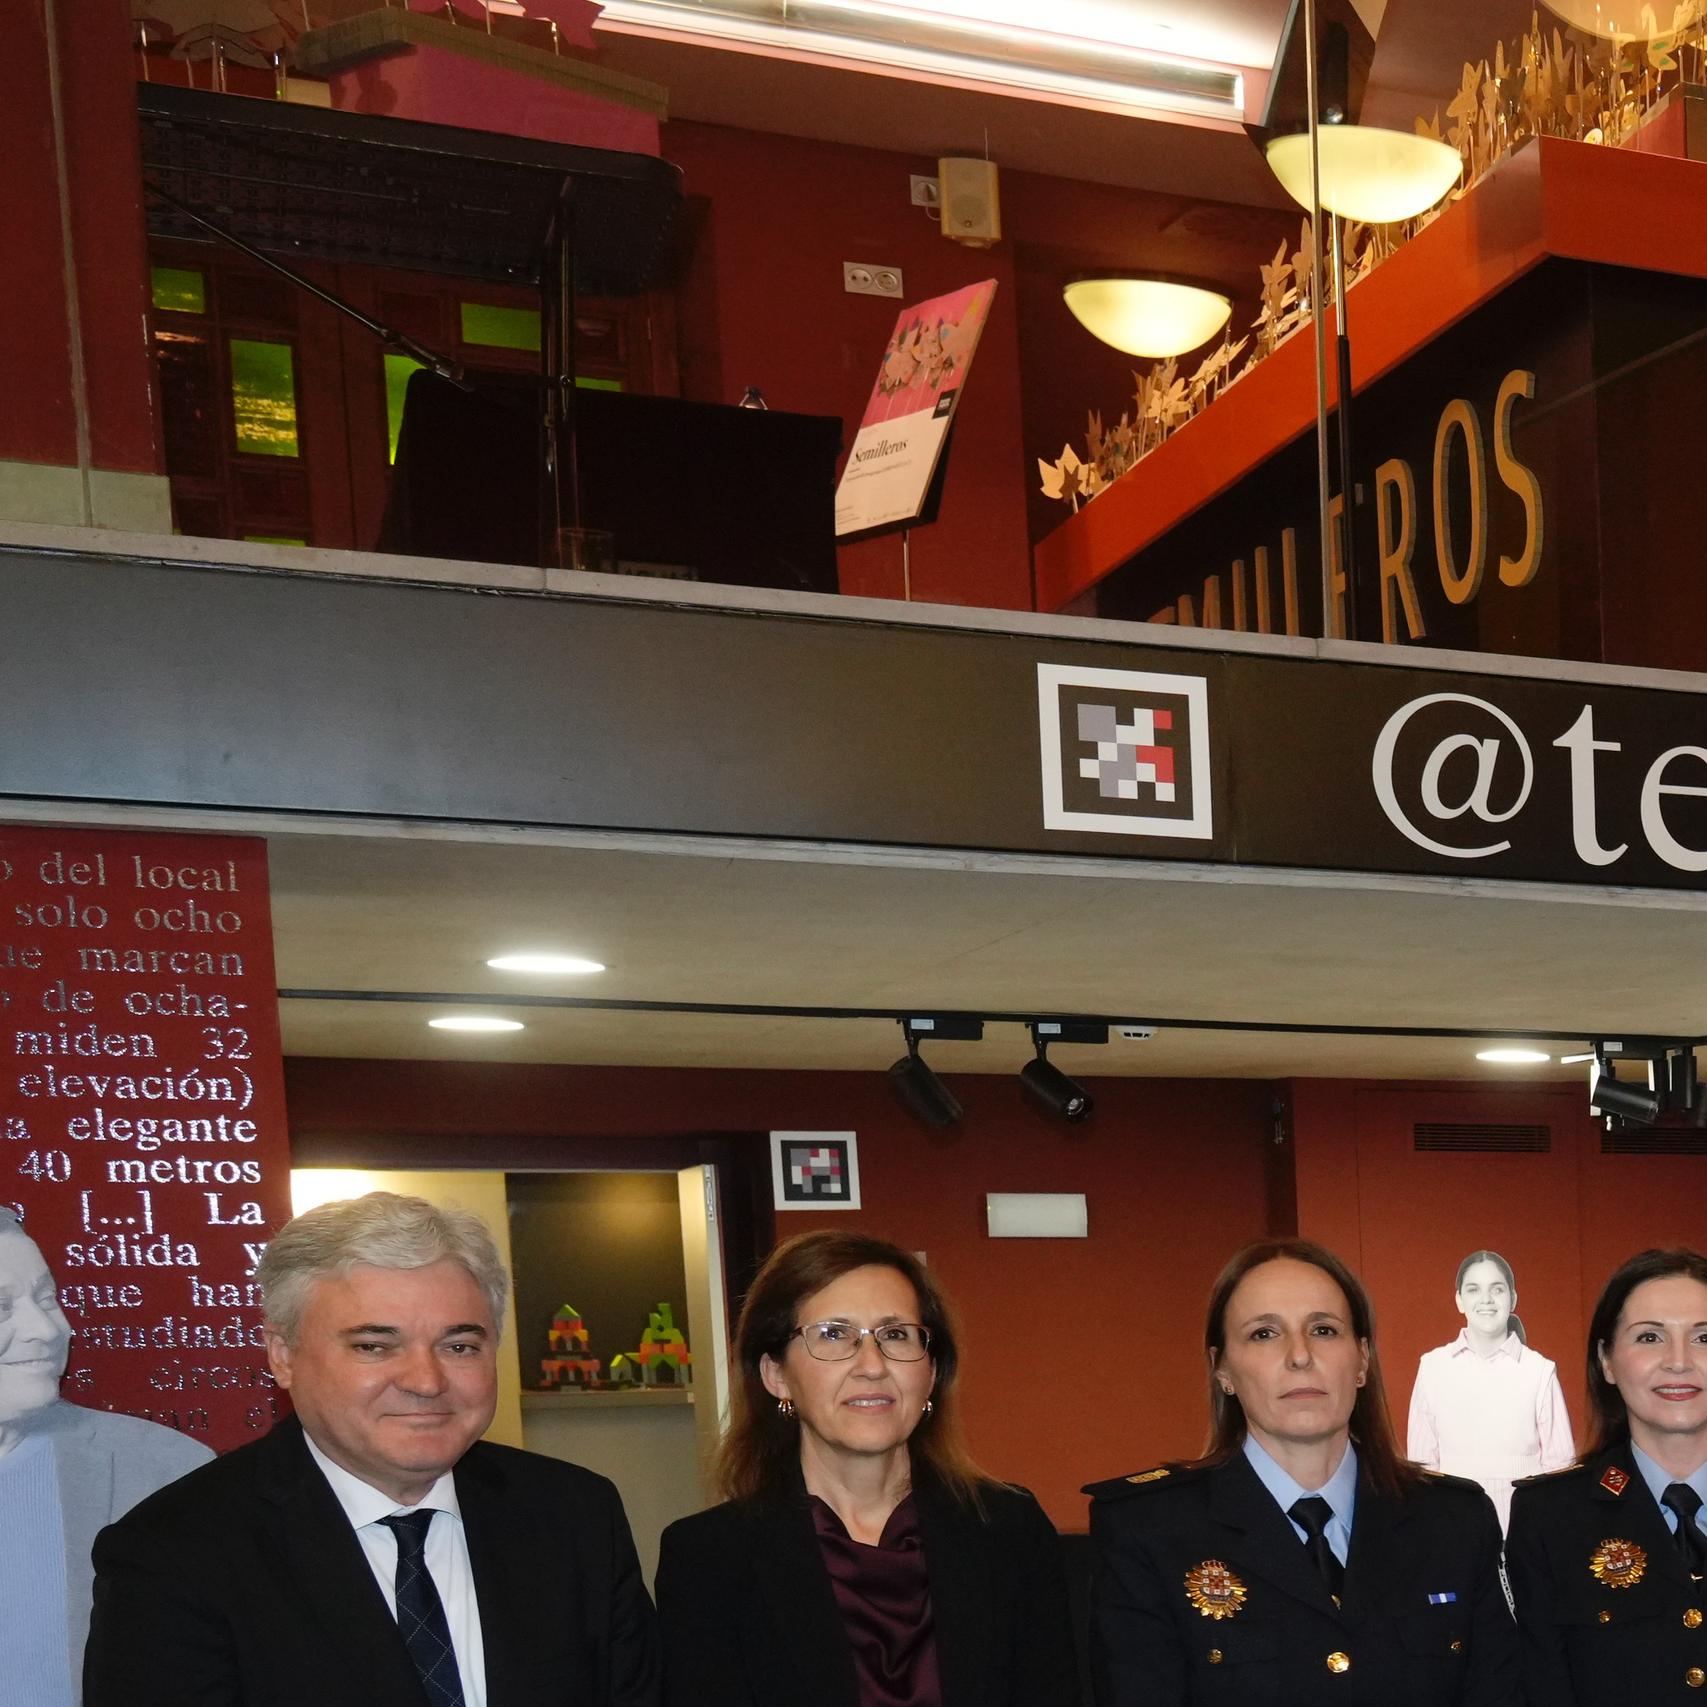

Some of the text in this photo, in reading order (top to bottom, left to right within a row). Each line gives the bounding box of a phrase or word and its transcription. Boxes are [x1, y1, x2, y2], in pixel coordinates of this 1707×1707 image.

[852, 440, 909, 465] Semilleros
[40, 852, 107, 885] del
[133, 855, 240, 892] local
[15, 896, 242, 934] solo ocho
[78, 948, 244, 976] marcan
[42, 979, 95, 1013] de
[125, 984, 248, 1018] ocha-
[15, 1022, 252, 1060] miden 32
[18, 1063, 254, 1111] elevación)
[67, 1107, 258, 1151] elegante
[17, 1150, 262, 1184] 40 metros
[203, 1192, 265, 1225] La
[65, 1233, 201, 1267] sólida
[60, 1284, 144, 1318] que
